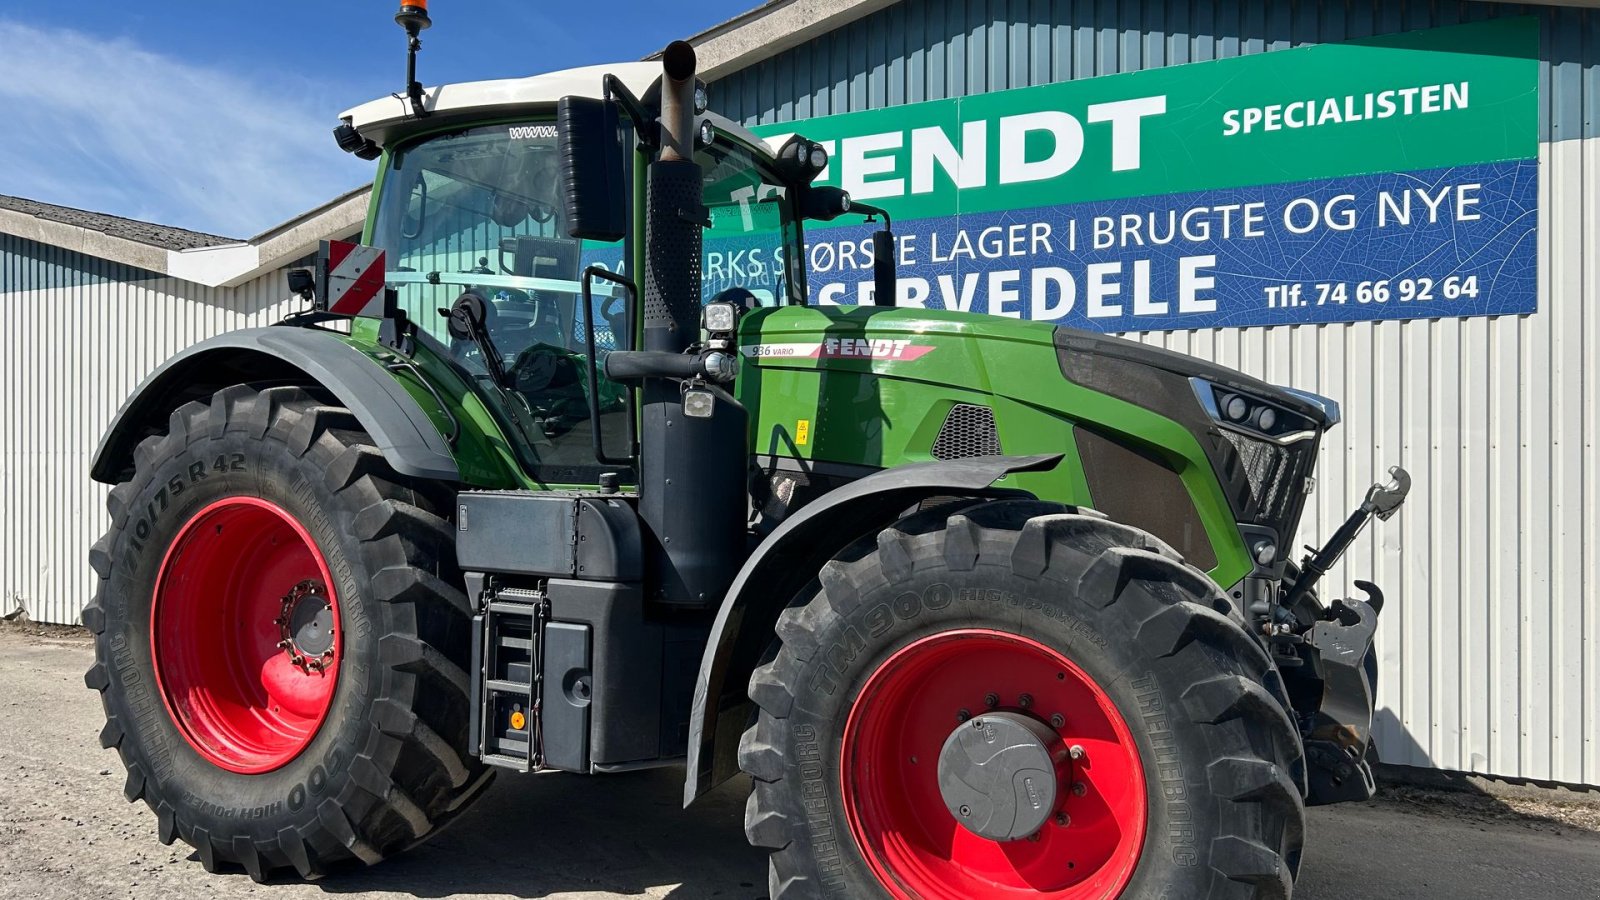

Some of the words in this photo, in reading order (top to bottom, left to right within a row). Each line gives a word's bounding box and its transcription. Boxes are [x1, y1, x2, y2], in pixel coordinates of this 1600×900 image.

[1222, 81, 1469, 137] SPECIALISTEN
[773, 234, 917, 277] SØRSE
[931, 222, 1053, 263] LAGER
[1069, 219, 1076, 251] I
[1093, 202, 1266, 250] BRUGTE
[1283, 194, 1356, 234] OG
[1378, 183, 1481, 227] NYE
[1264, 284, 1307, 308] Tlf.
[1315, 282, 1348, 306] 74
[1356, 280, 1390, 303] 66
[1399, 277, 1433, 301] 92
[1443, 275, 1479, 299] 64
[752, 345, 771, 356] 936
[772, 348, 795, 356] VARIO
[825, 338, 912, 358] FENDT
[188, 459, 209, 483] R
[213, 452, 248, 474] 42
[1130, 672, 1200, 868] TRELLEBORG
